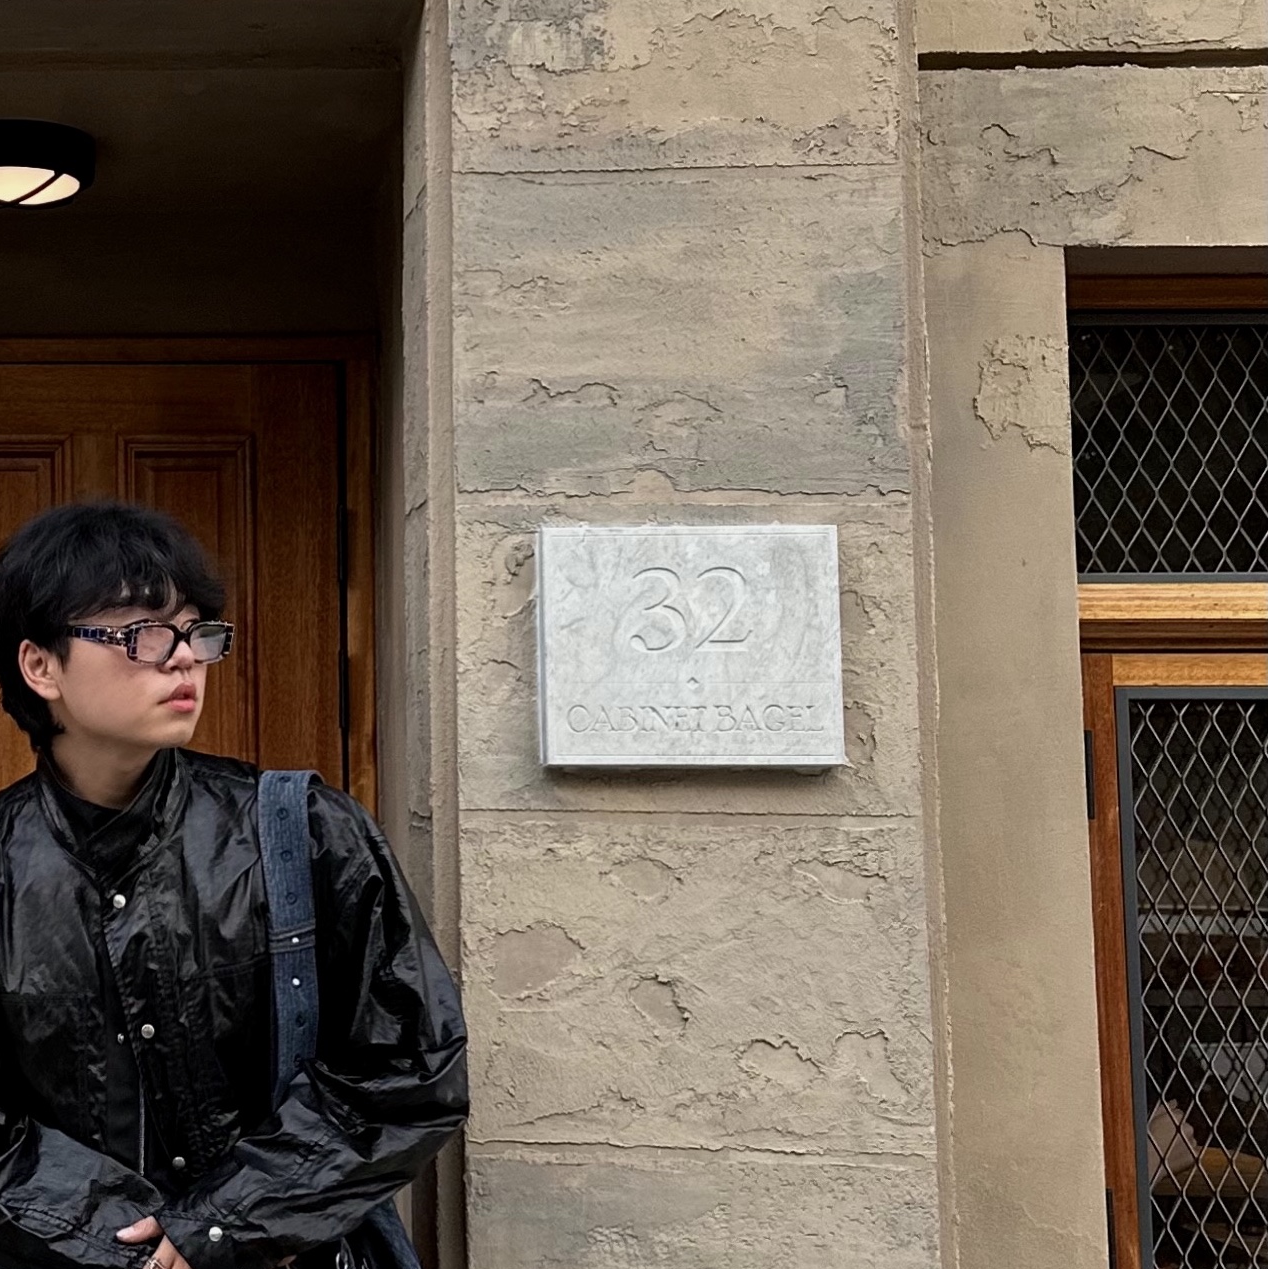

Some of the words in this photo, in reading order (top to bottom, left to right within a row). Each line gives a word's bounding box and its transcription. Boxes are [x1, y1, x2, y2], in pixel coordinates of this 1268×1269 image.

[630, 566, 754, 653] 32
[566, 703, 707, 733] CABINET
[712, 703, 824, 733] BAGEL
